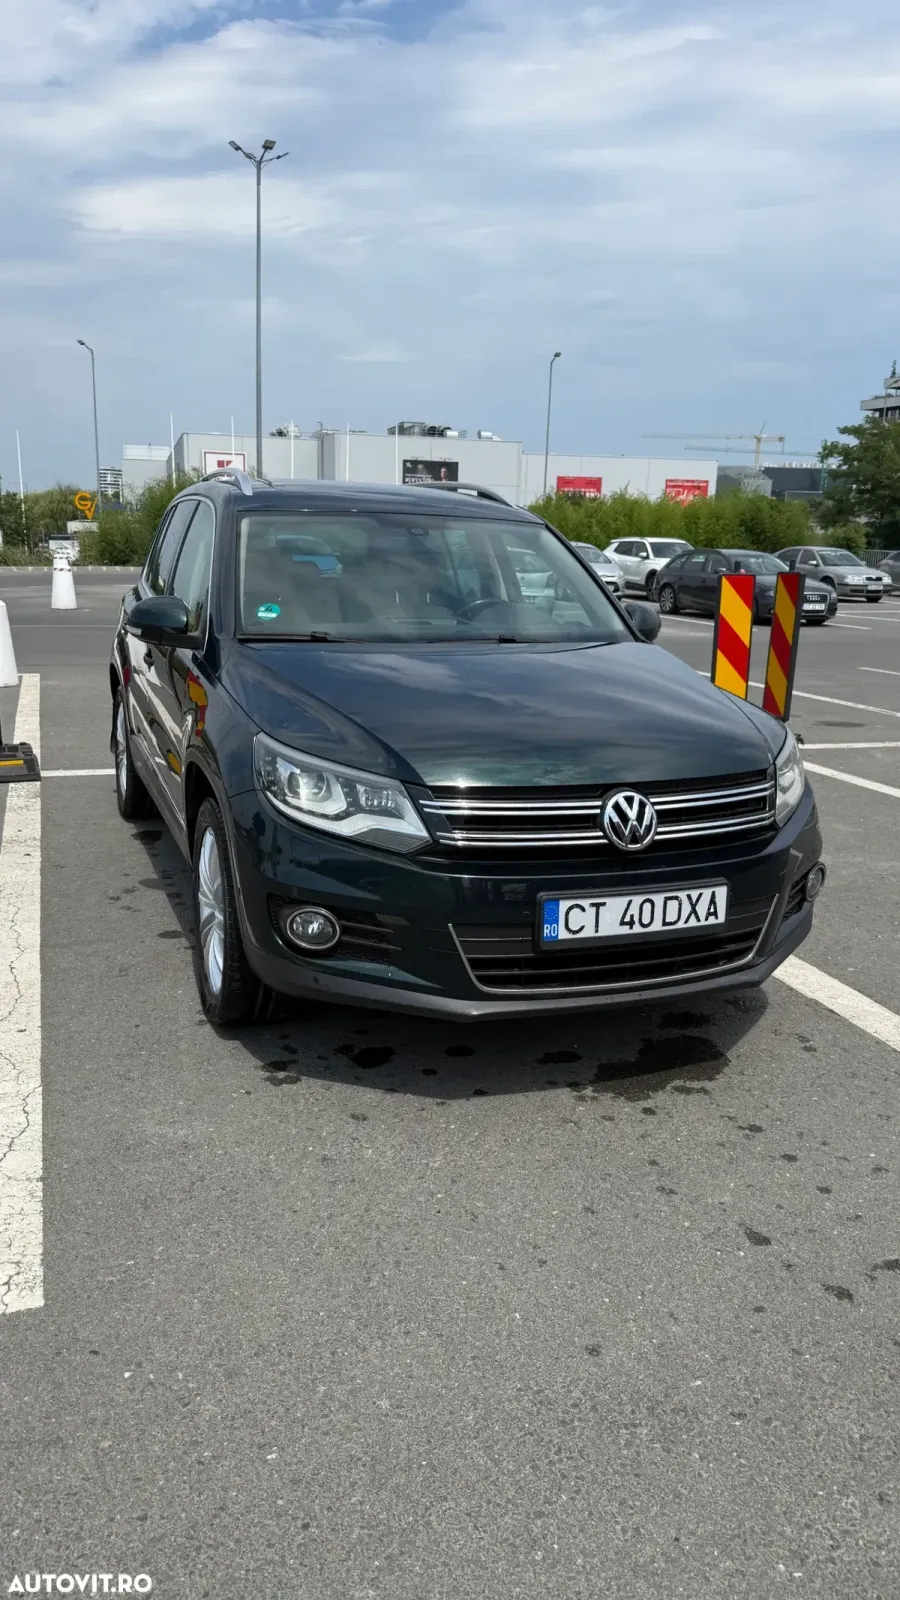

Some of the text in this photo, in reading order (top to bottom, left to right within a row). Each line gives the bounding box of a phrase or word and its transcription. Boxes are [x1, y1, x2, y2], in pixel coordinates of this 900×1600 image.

[604, 791, 656, 848] VW
[543, 924, 558, 937] RO
[564, 890, 719, 935] CT 40 DXA
